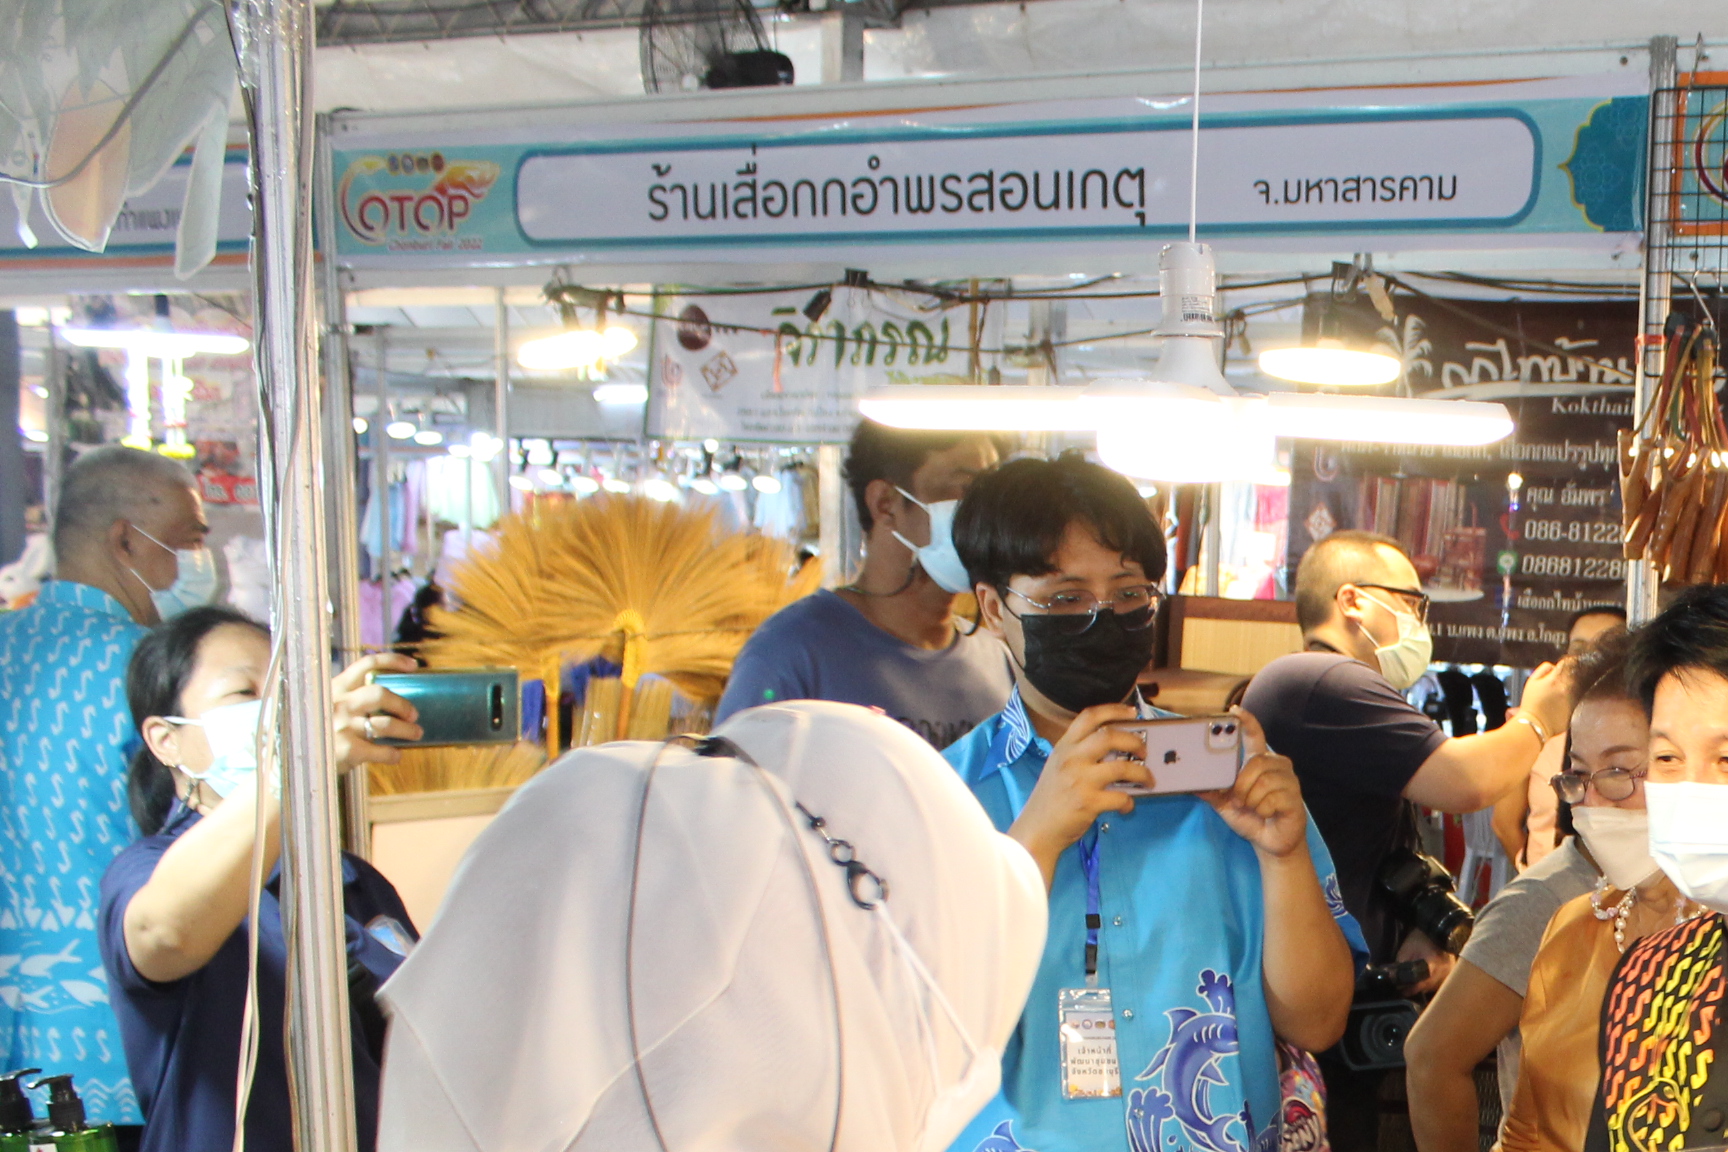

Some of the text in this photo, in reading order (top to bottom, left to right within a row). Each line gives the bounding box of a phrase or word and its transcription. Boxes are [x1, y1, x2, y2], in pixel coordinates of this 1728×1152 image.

[647, 144, 1147, 227] ร้านเสื่อกกอำพรสอนเกตุ
[1253, 175, 1457, 205] จ.มหาสารคาม
[358, 193, 470, 232] OTOP
[1071, 1067, 1119, 1077] จังหวัดชบุรี
